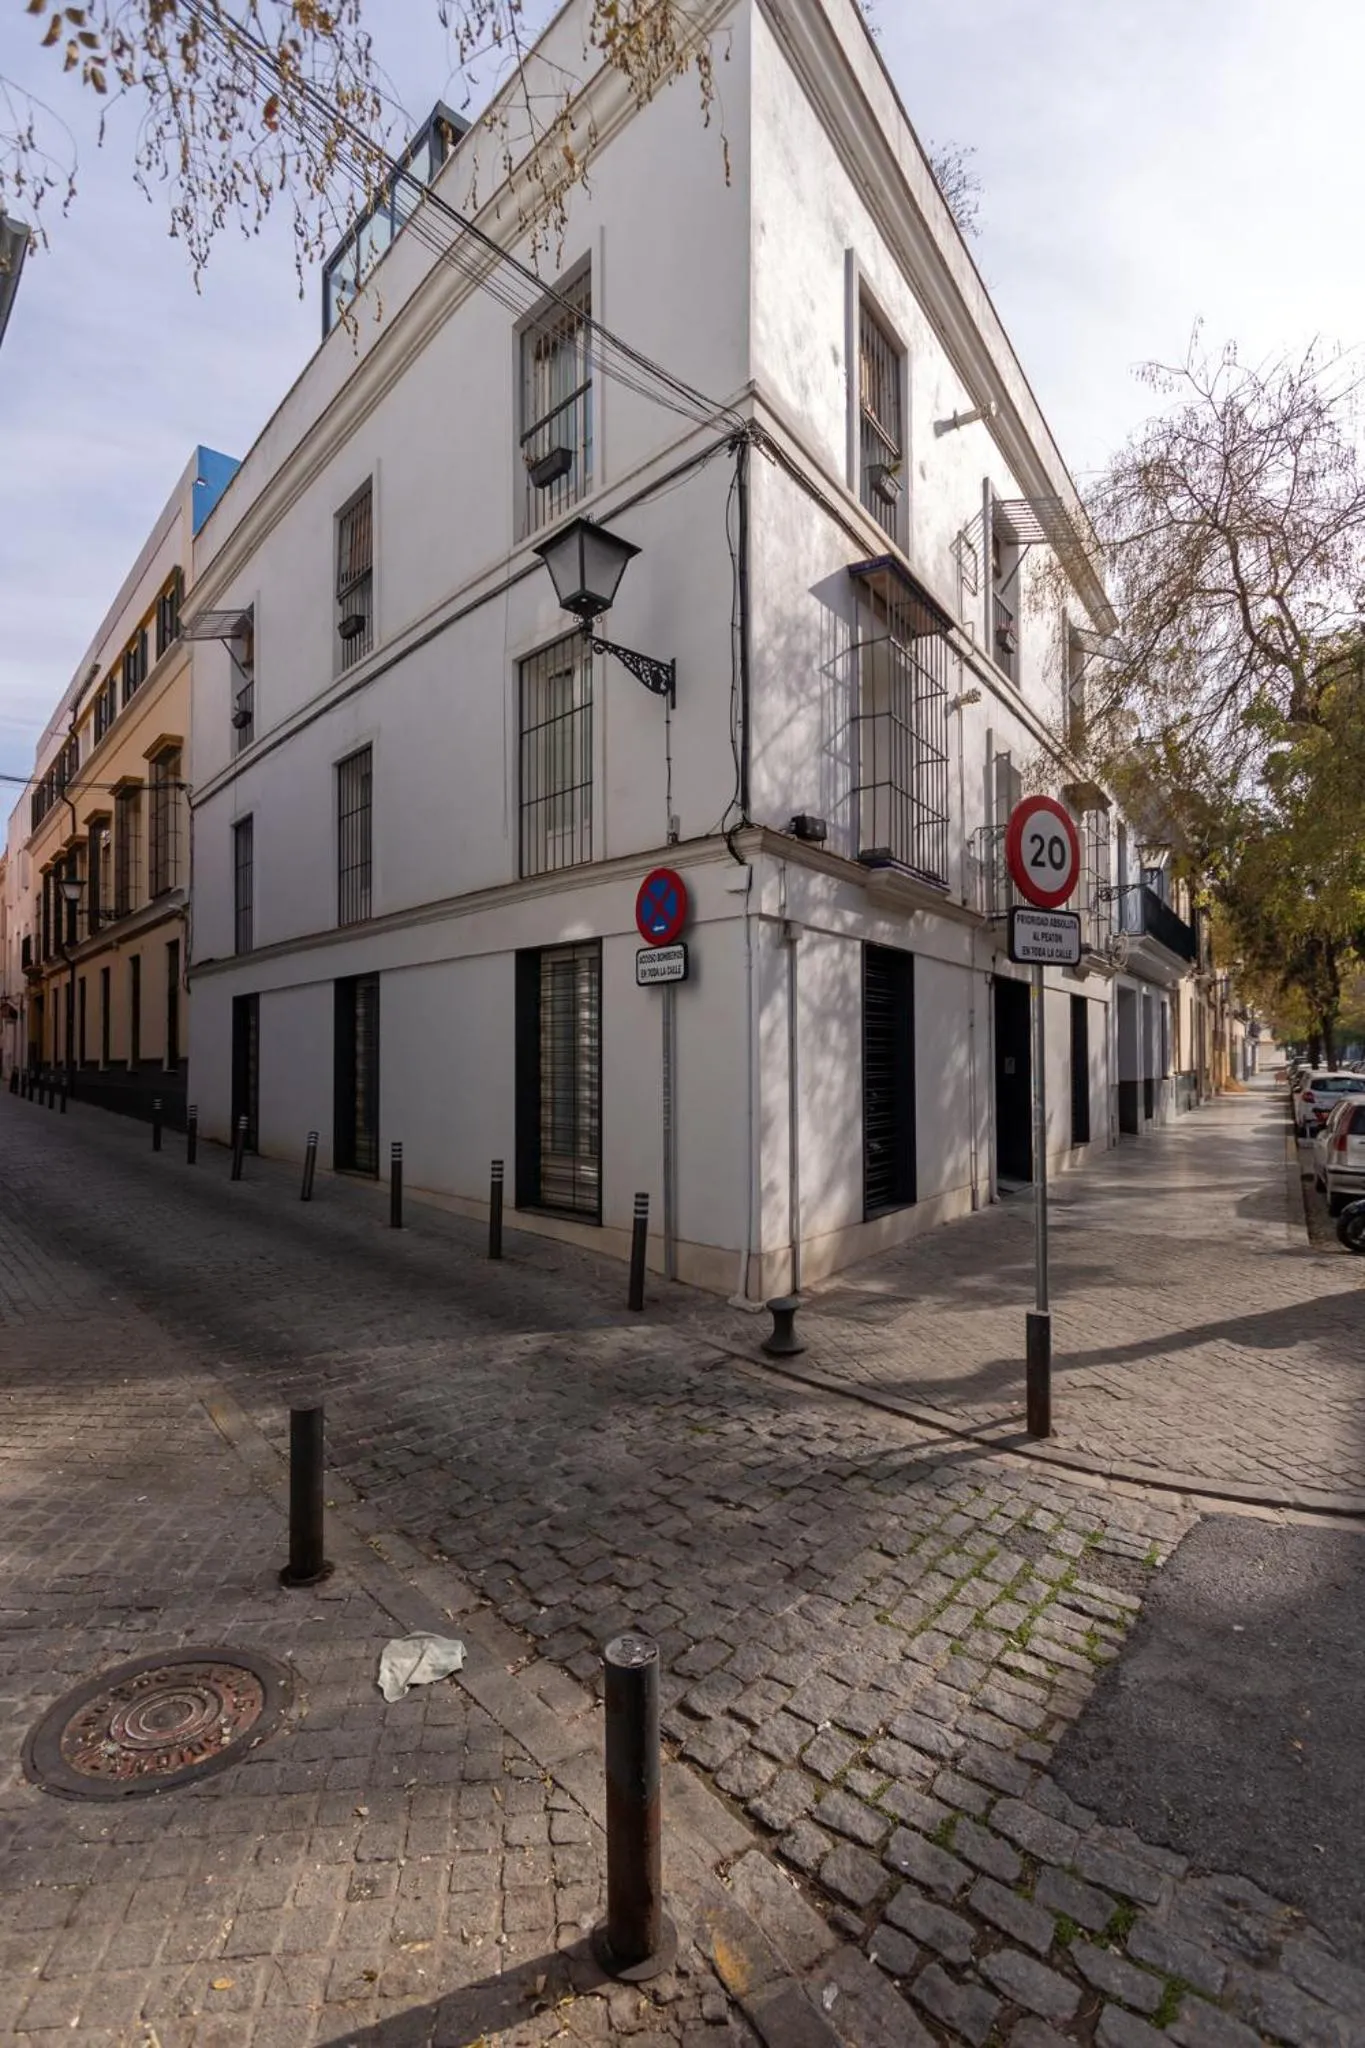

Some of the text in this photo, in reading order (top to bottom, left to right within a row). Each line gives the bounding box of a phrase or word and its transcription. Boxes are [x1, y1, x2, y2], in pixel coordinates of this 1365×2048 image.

[1030, 833, 1066, 871] 20
[1017, 914, 1077, 929] PRIORIDAD ABSOLUTA
[1033, 932, 1040, 941] AL
[1023, 946, 1072, 959] EN TODA LA CALLE
